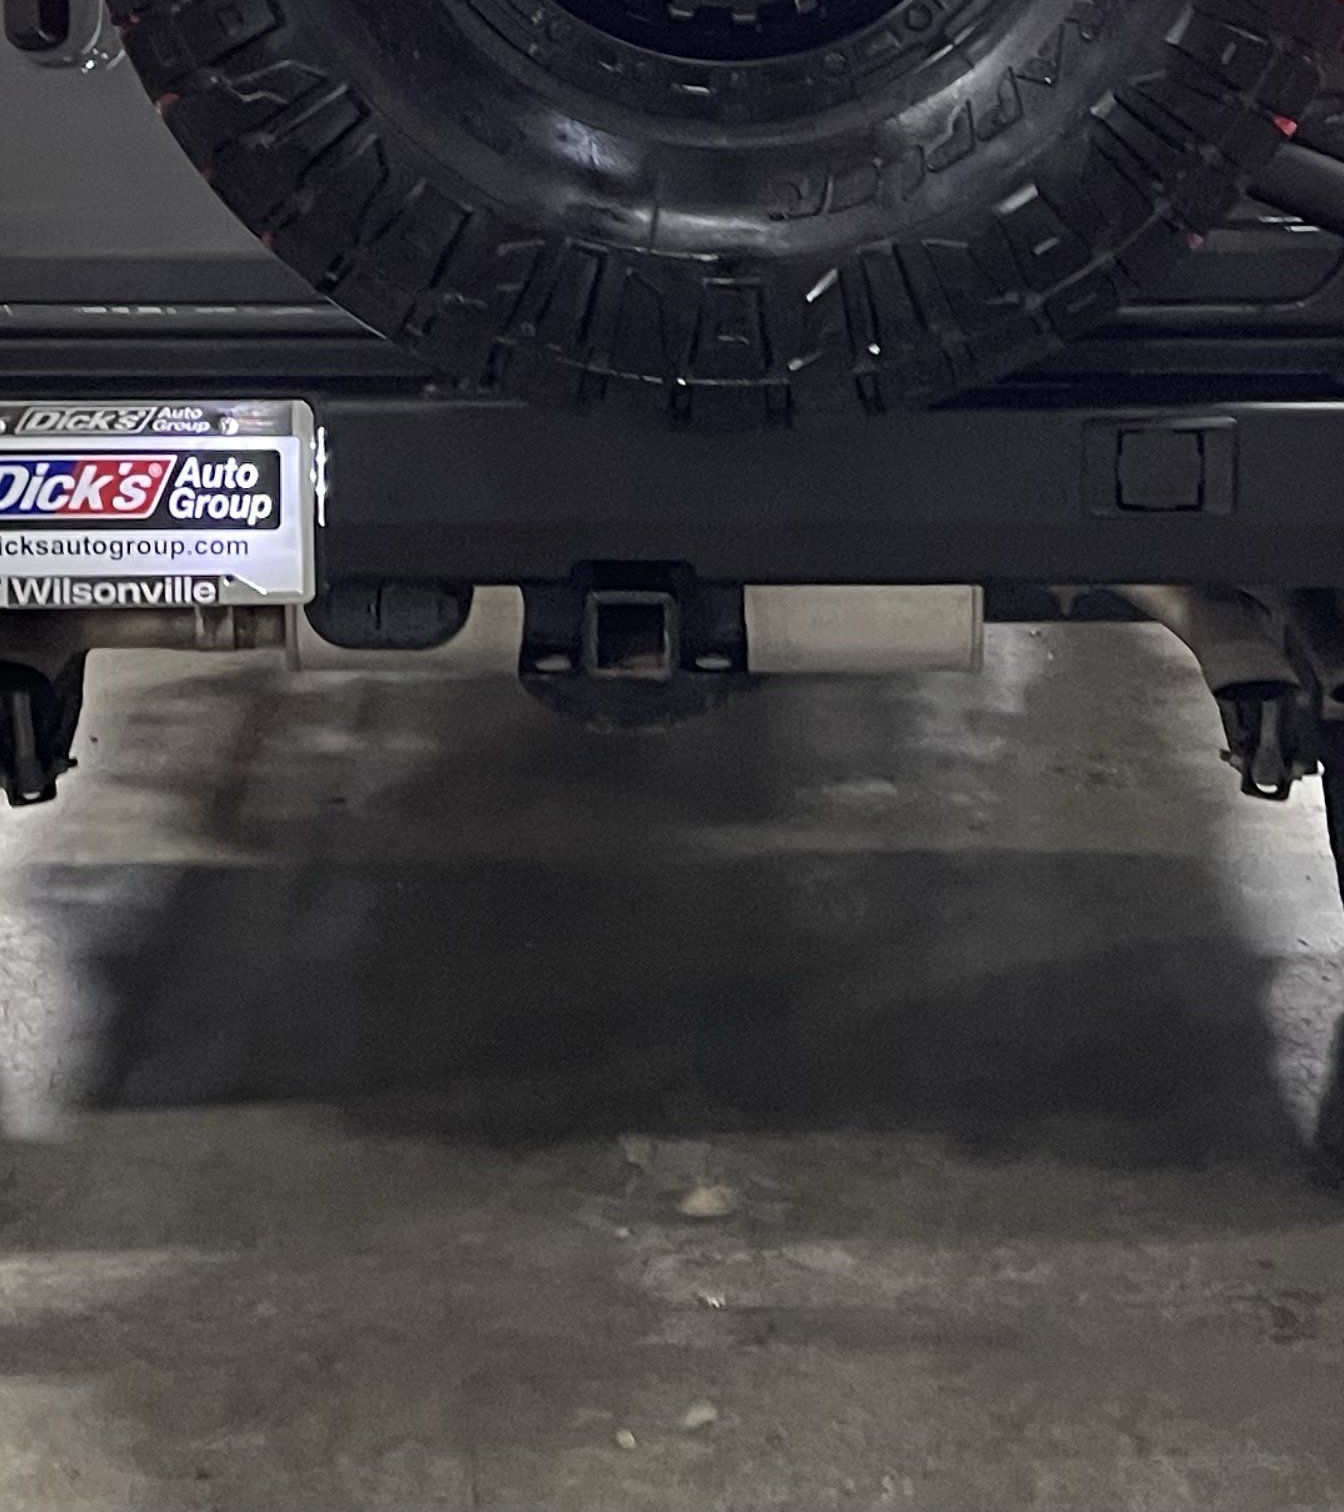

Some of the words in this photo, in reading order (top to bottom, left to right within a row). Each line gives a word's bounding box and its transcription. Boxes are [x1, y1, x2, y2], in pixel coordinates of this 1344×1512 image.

[152, 419, 211, 435] Group
[158, 406, 204, 420] Auto
[175, 456, 259, 489] Auto
[168, 488, 272, 526] Group
[10, 577, 217, 605] Wilsonville
